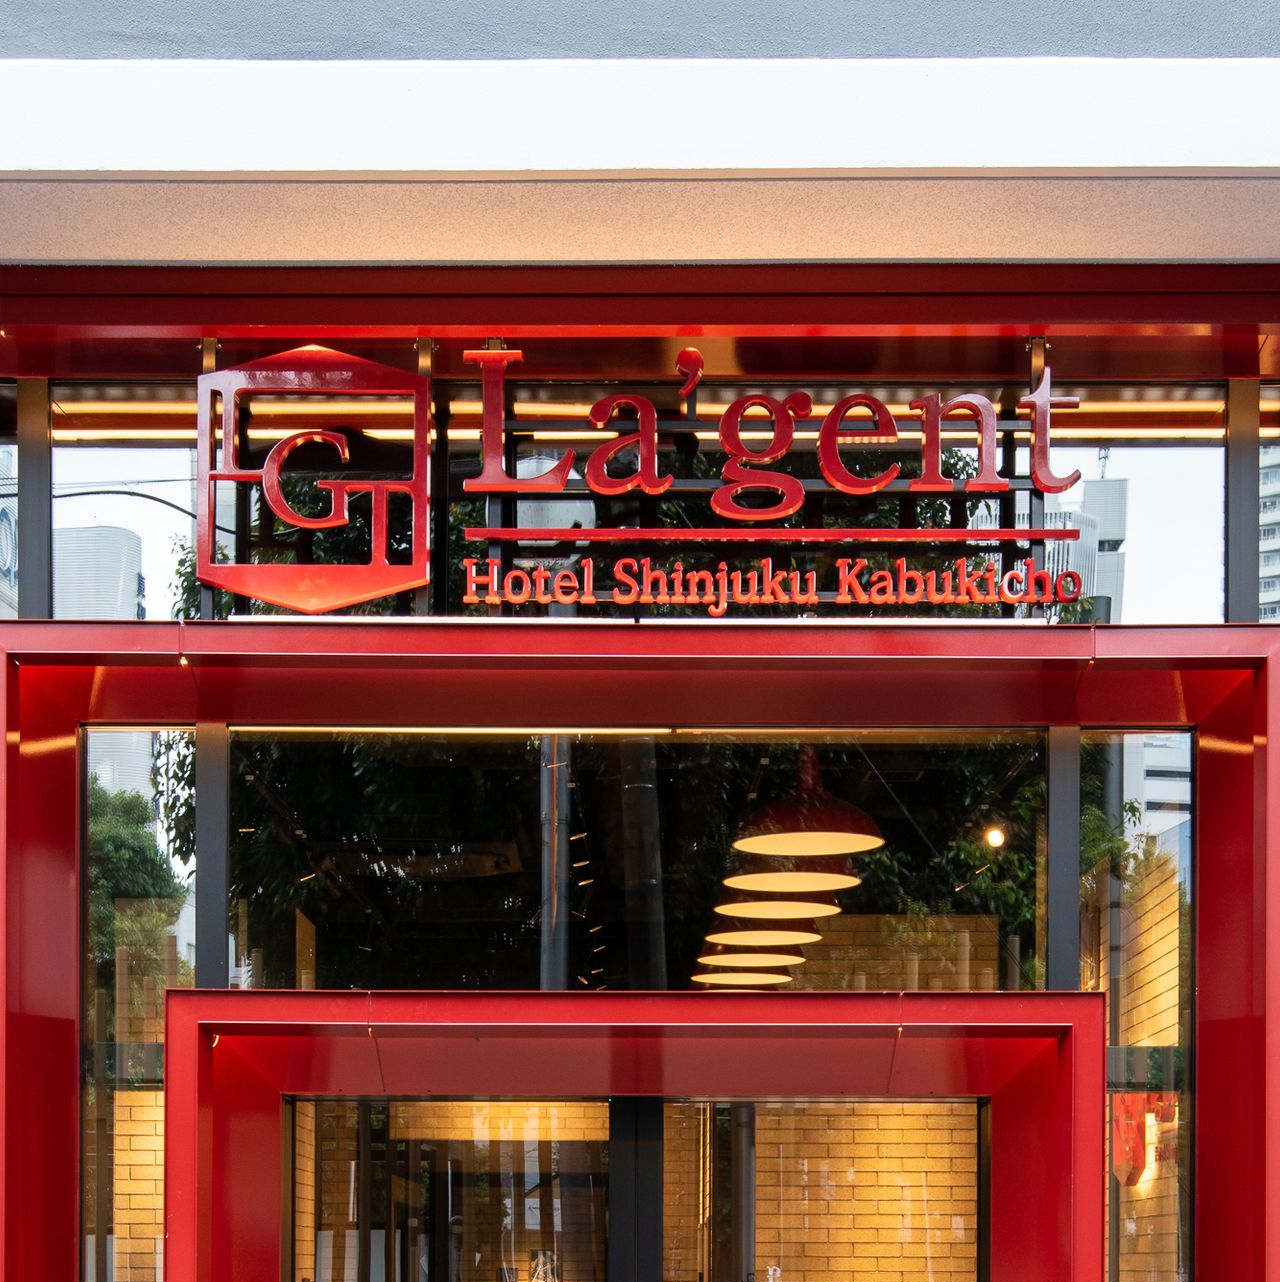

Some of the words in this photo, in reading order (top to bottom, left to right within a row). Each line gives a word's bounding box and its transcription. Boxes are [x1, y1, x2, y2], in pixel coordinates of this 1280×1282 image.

[462, 557, 596, 605] Hotel
[612, 556, 818, 617] Shinjuku
[834, 556, 1083, 605] Kabukicho
